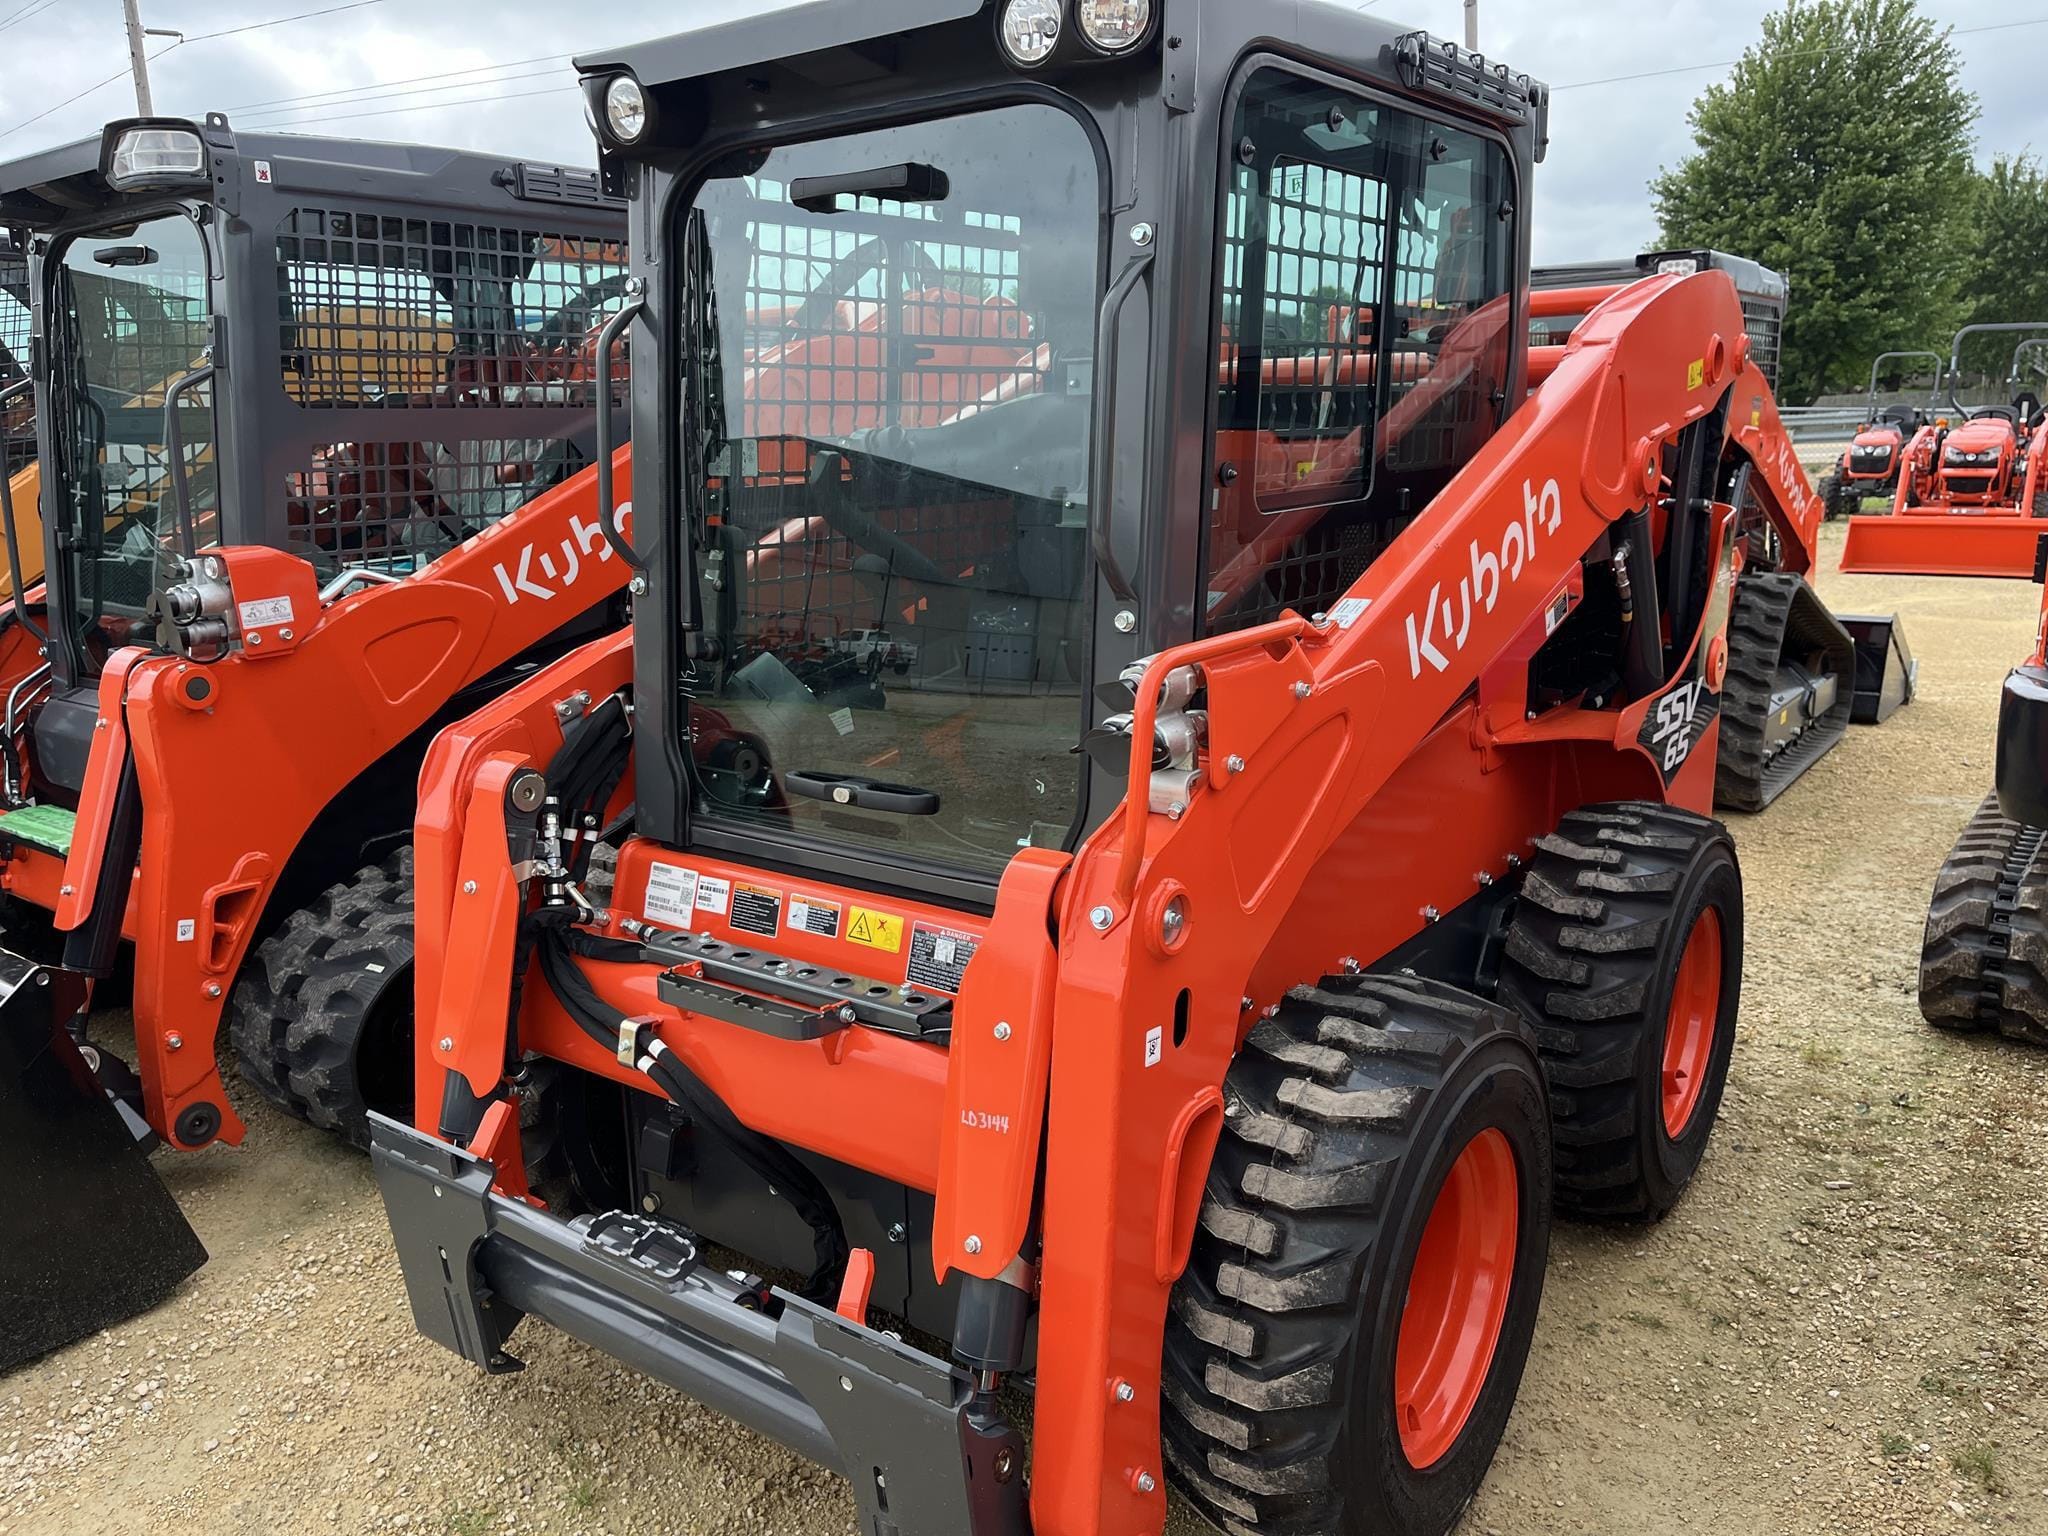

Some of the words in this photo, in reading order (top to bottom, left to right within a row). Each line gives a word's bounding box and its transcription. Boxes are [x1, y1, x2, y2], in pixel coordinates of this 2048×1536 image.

[1405, 478, 1562, 680] Kubota
[1652, 675, 1704, 744] SSV
[1663, 724, 1691, 772] 65
[946, 929, 972, 942] DANGER
[961, 1109, 1009, 1134] LD3144
